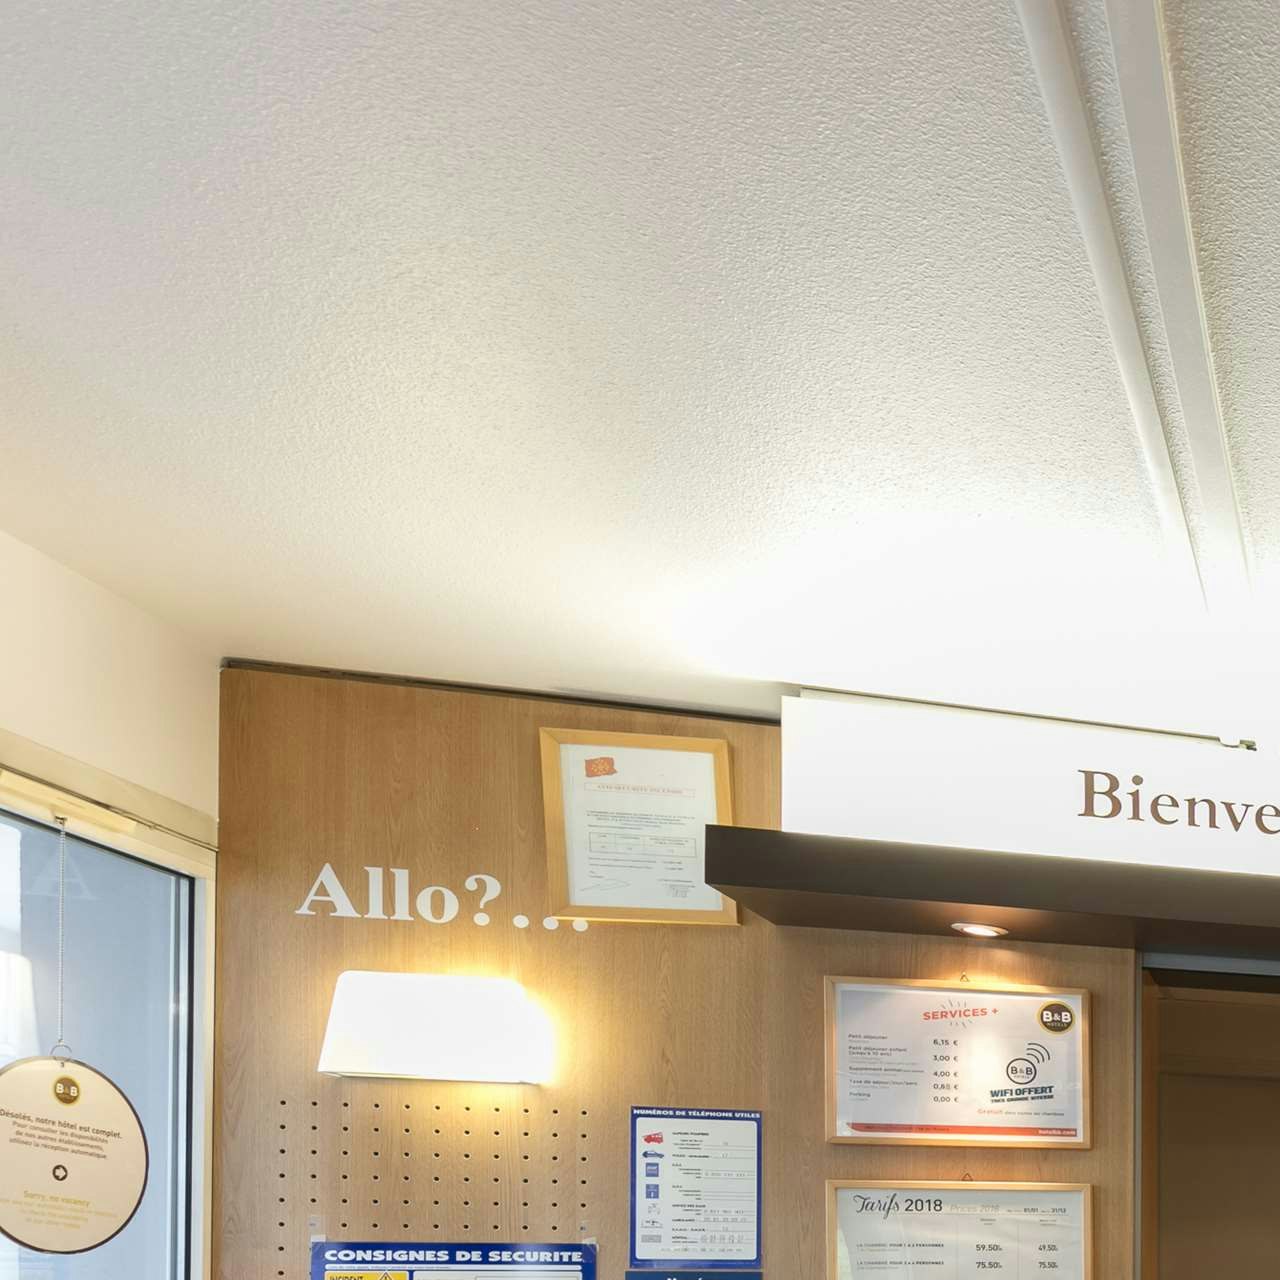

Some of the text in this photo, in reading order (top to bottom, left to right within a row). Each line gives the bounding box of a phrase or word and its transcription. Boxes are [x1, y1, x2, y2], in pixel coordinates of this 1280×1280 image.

[923, 1008, 988, 1020] SERVICES
[1042, 1010, 1071, 1023] B&B
[990, 1086, 1054, 1097] WIFI OFFERT
[688, 1109, 732, 1118] TÉLÉPHONE
[35, 1116, 56, 1127] notre
[58, 1119, 77, 1131] hôtel
[79, 1123, 90, 1132] est
[92, 1126, 122, 1139] complet.
[853, 1193, 942, 1220] Tarifs 2018
[324, 1250, 583, 1263] CONSIGNES DE SECURITE
